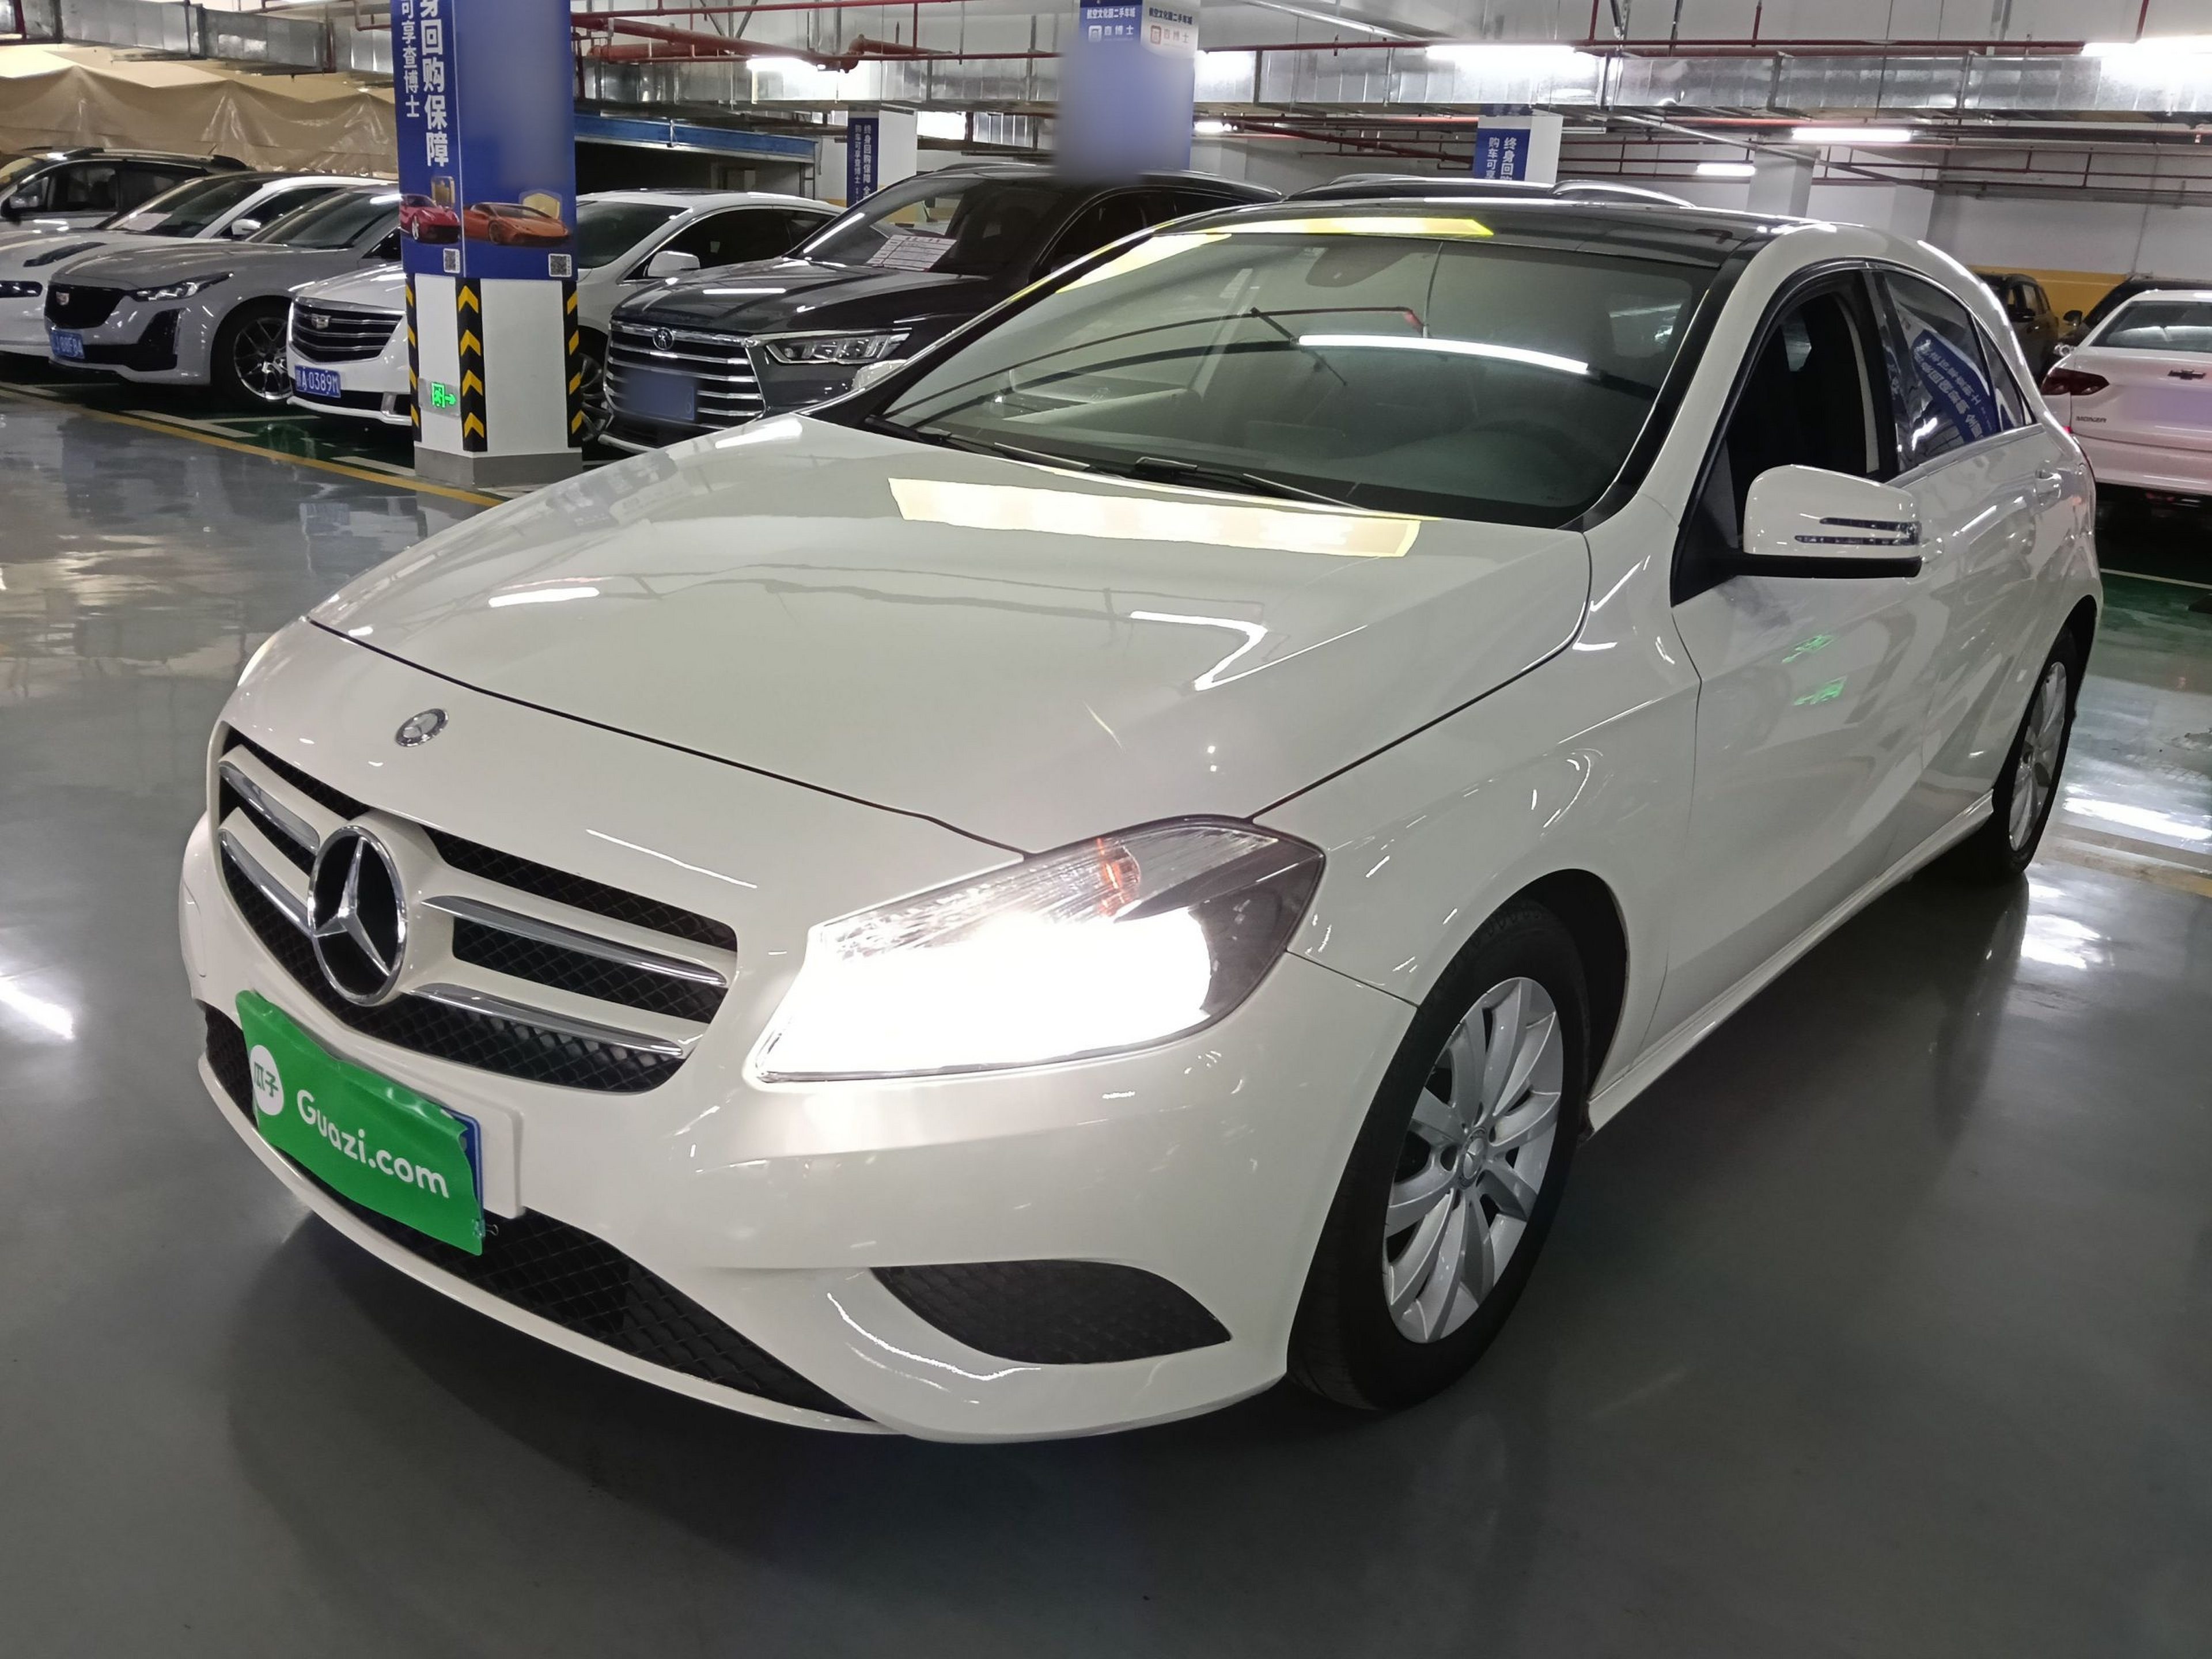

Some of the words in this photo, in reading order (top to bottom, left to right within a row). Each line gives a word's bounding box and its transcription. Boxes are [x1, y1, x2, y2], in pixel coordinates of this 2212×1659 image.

[402, 0, 419, 118] 可享查博士
[254, 1061, 279, 1097] 瓜子
[297, 1089, 449, 1198] Guazi.com
